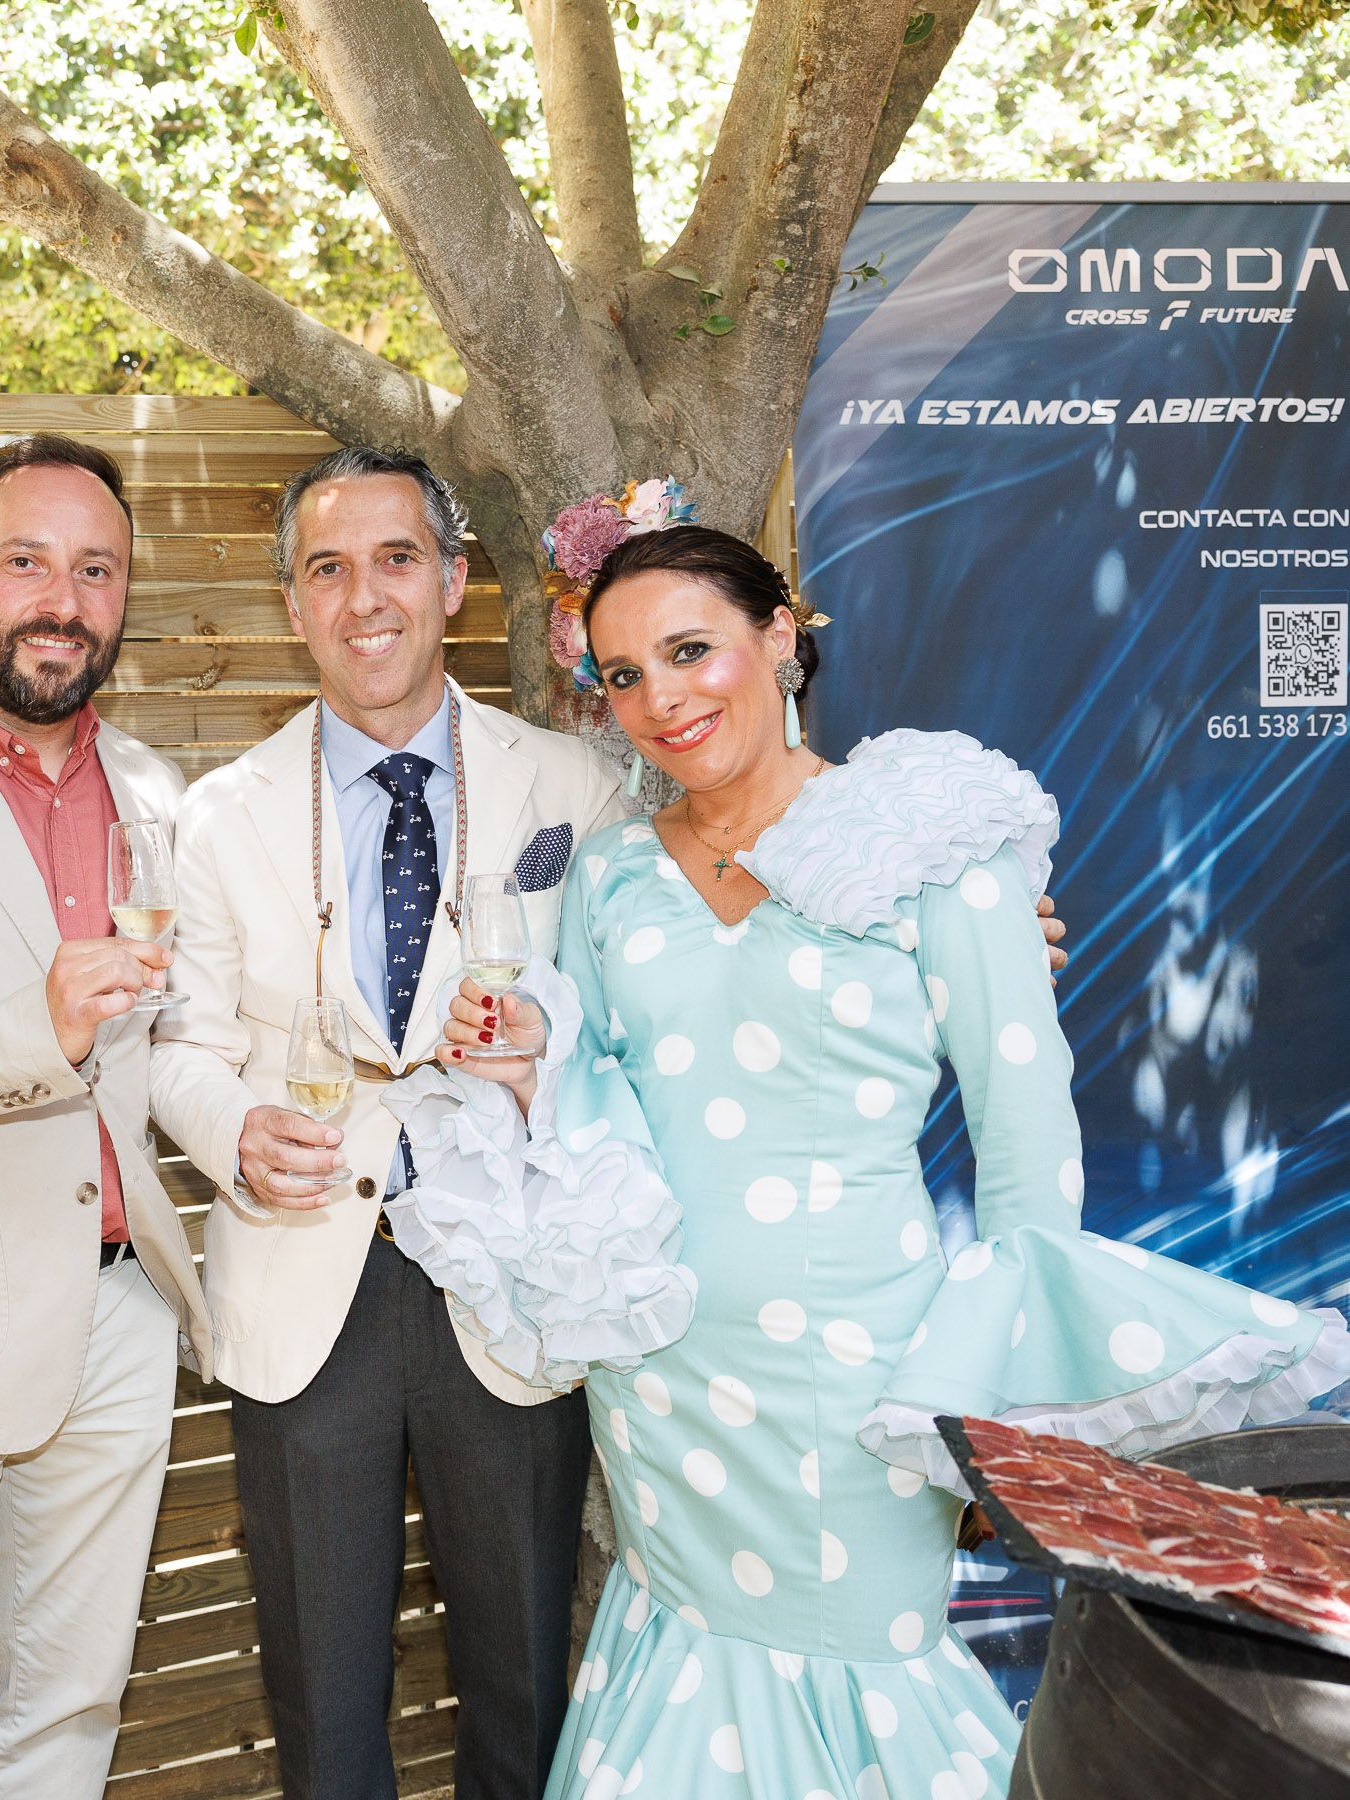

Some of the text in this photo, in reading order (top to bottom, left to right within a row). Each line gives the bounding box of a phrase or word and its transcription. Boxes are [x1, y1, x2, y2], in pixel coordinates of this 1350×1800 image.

[1008, 247, 1349, 293] OMODA
[1065, 307, 1297, 325] CROSS FUTURE
[917, 399, 1122, 425] ESTAMOS
[1126, 398, 1346, 424] ABIERTOS!
[1139, 508, 1350, 529] CONTACTA CON
[1200, 549, 1349, 568] NOSOTROS
[1207, 713, 1348, 739] 661 538 173
